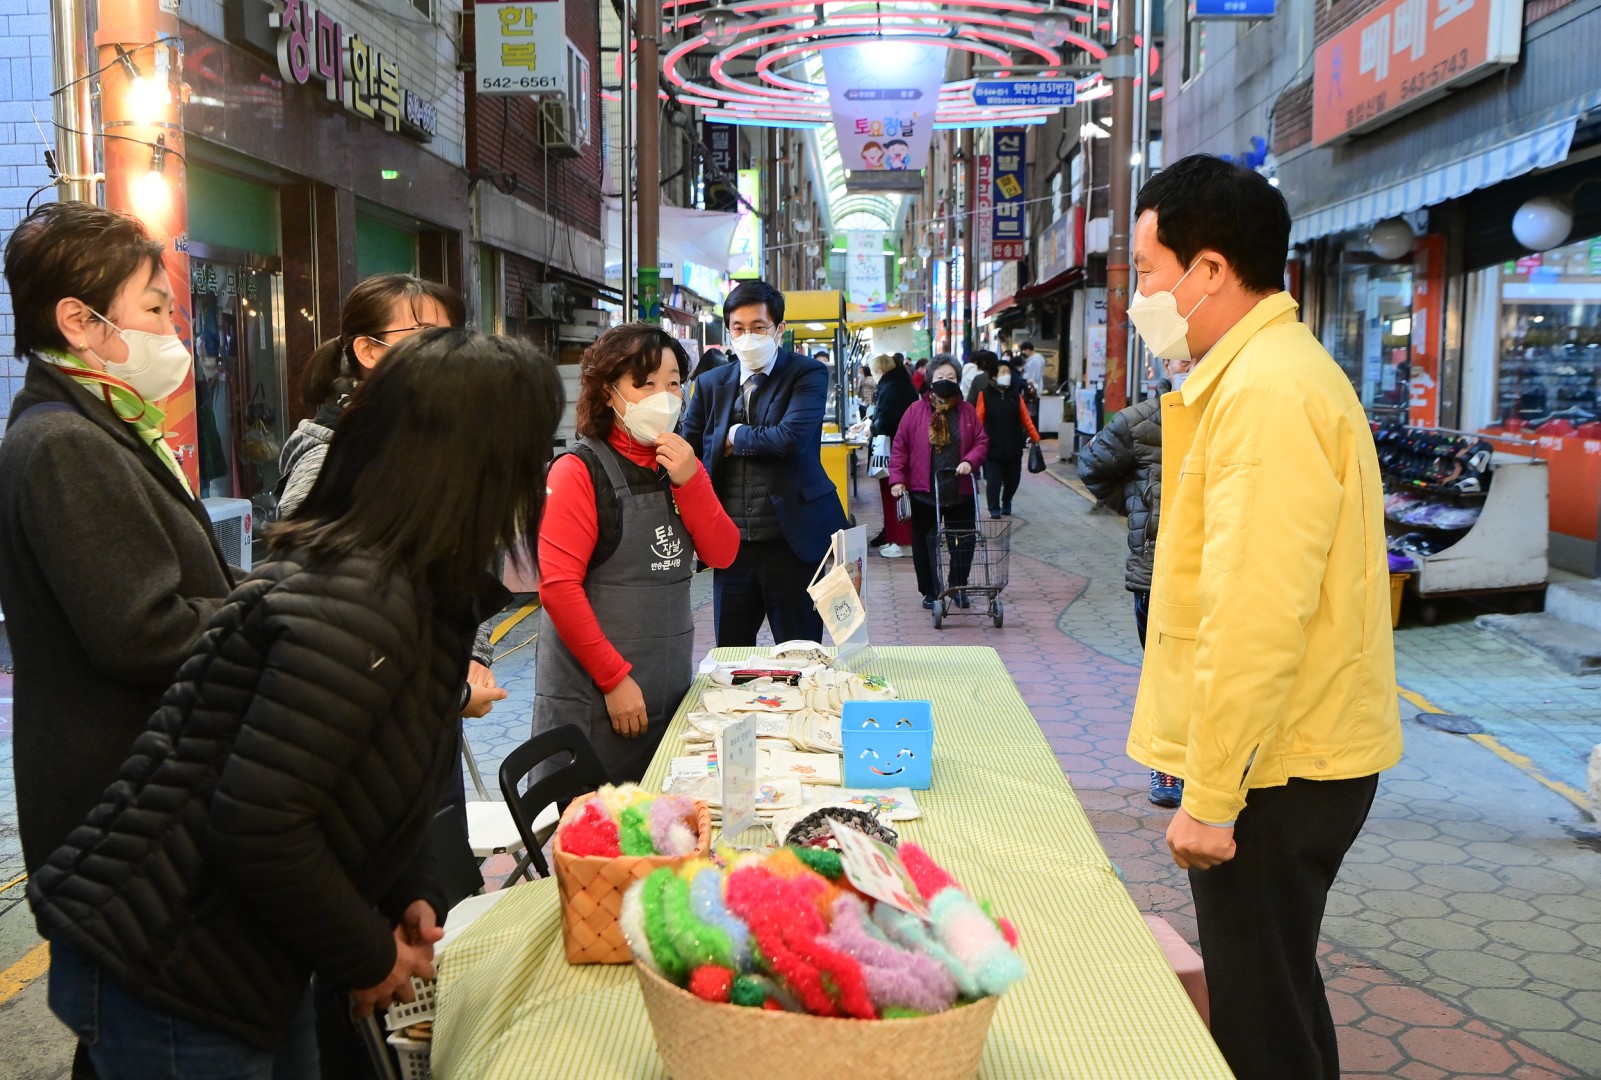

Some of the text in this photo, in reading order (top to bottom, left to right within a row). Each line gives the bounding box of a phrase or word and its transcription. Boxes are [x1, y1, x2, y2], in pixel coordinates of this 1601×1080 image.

[498, 6, 537, 71] 한복
[483, 76, 556, 88] 542-6561
[1401, 48, 1468, 100] 543-5743
[854, 117, 916, 137] 토요장날
[998, 135, 1020, 171] 신발
[996, 202, 1020, 236] 마트
[993, 244, 1023, 257] 반송점
[872, 455, 890, 468] NIK
[244, 535, 251, 545] LG
